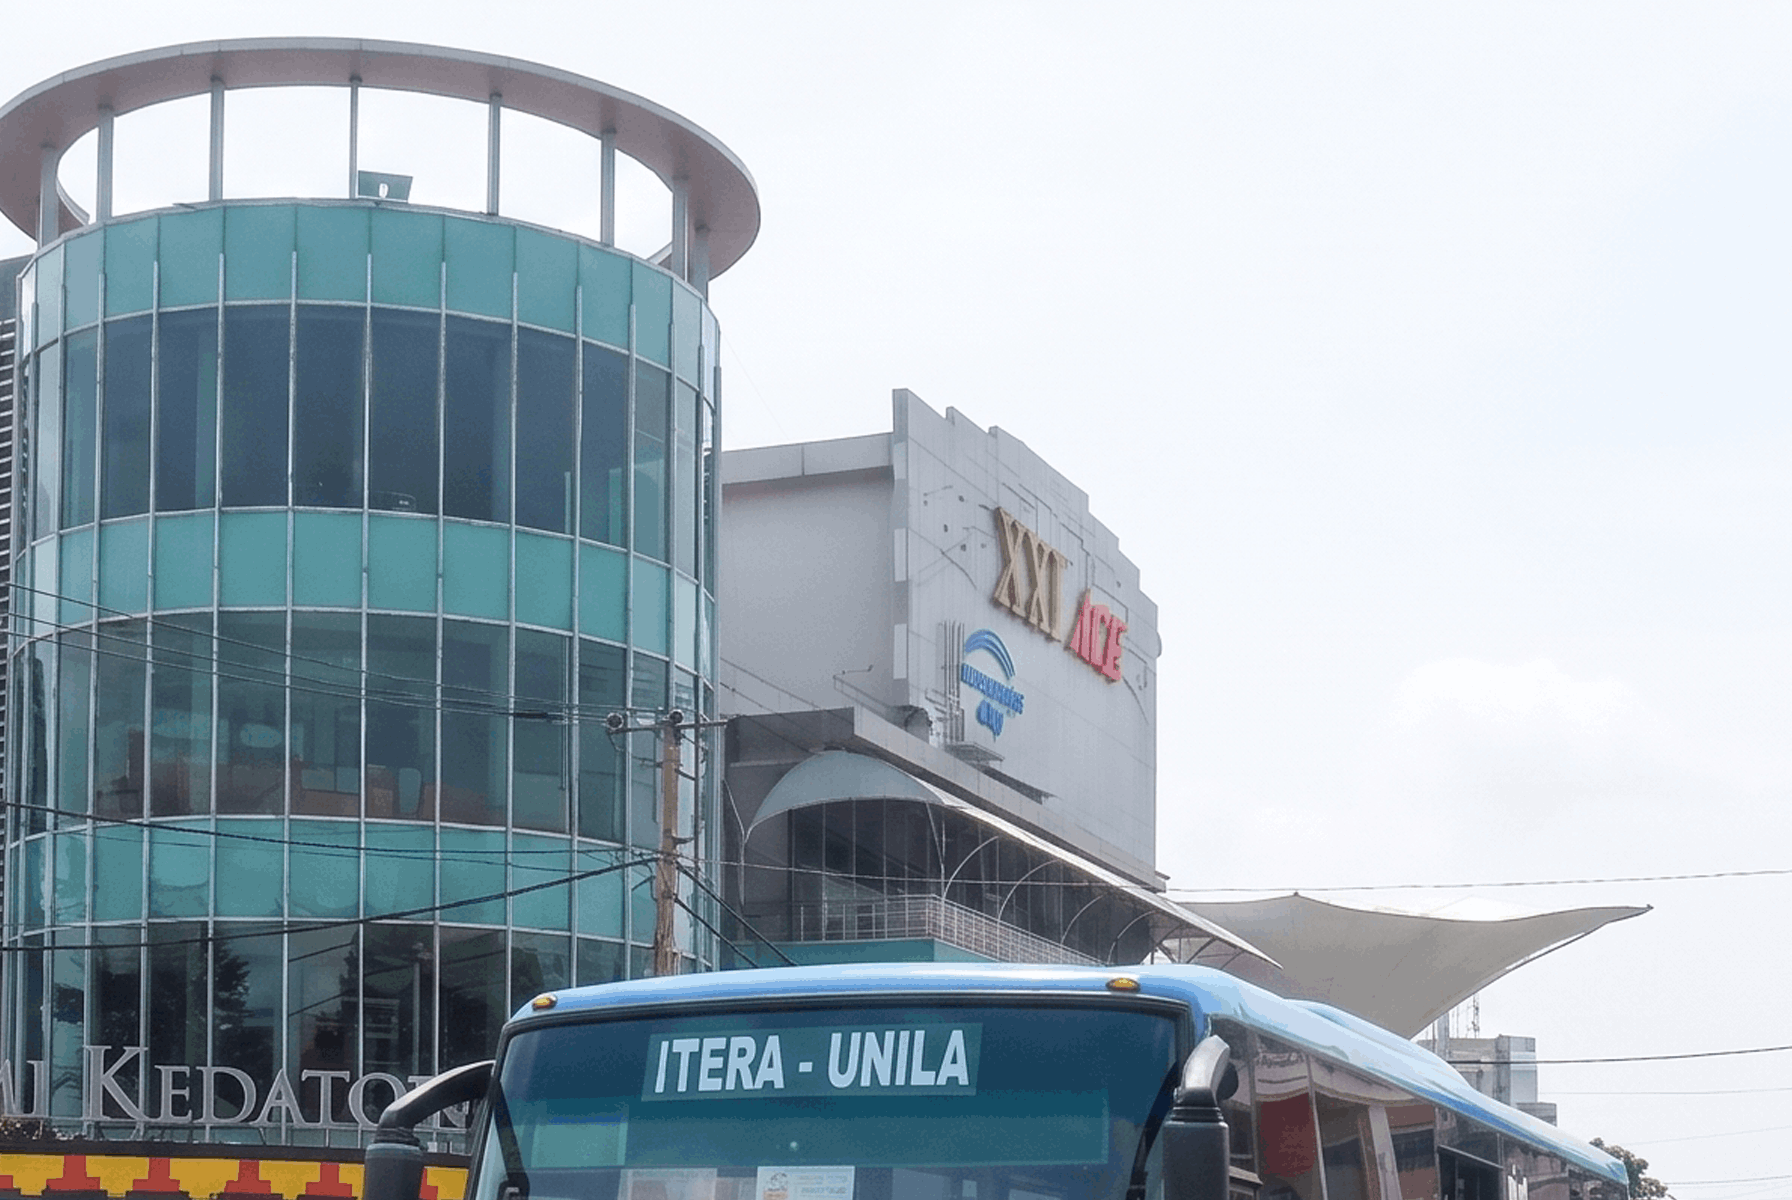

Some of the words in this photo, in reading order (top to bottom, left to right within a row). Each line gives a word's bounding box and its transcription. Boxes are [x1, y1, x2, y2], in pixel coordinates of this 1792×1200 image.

[992, 505, 1068, 643] XXI
[1067, 588, 1128, 683] ACE
[654, 1034, 785, 1094] ITERA
[827, 1029, 970, 1089] UNILA
